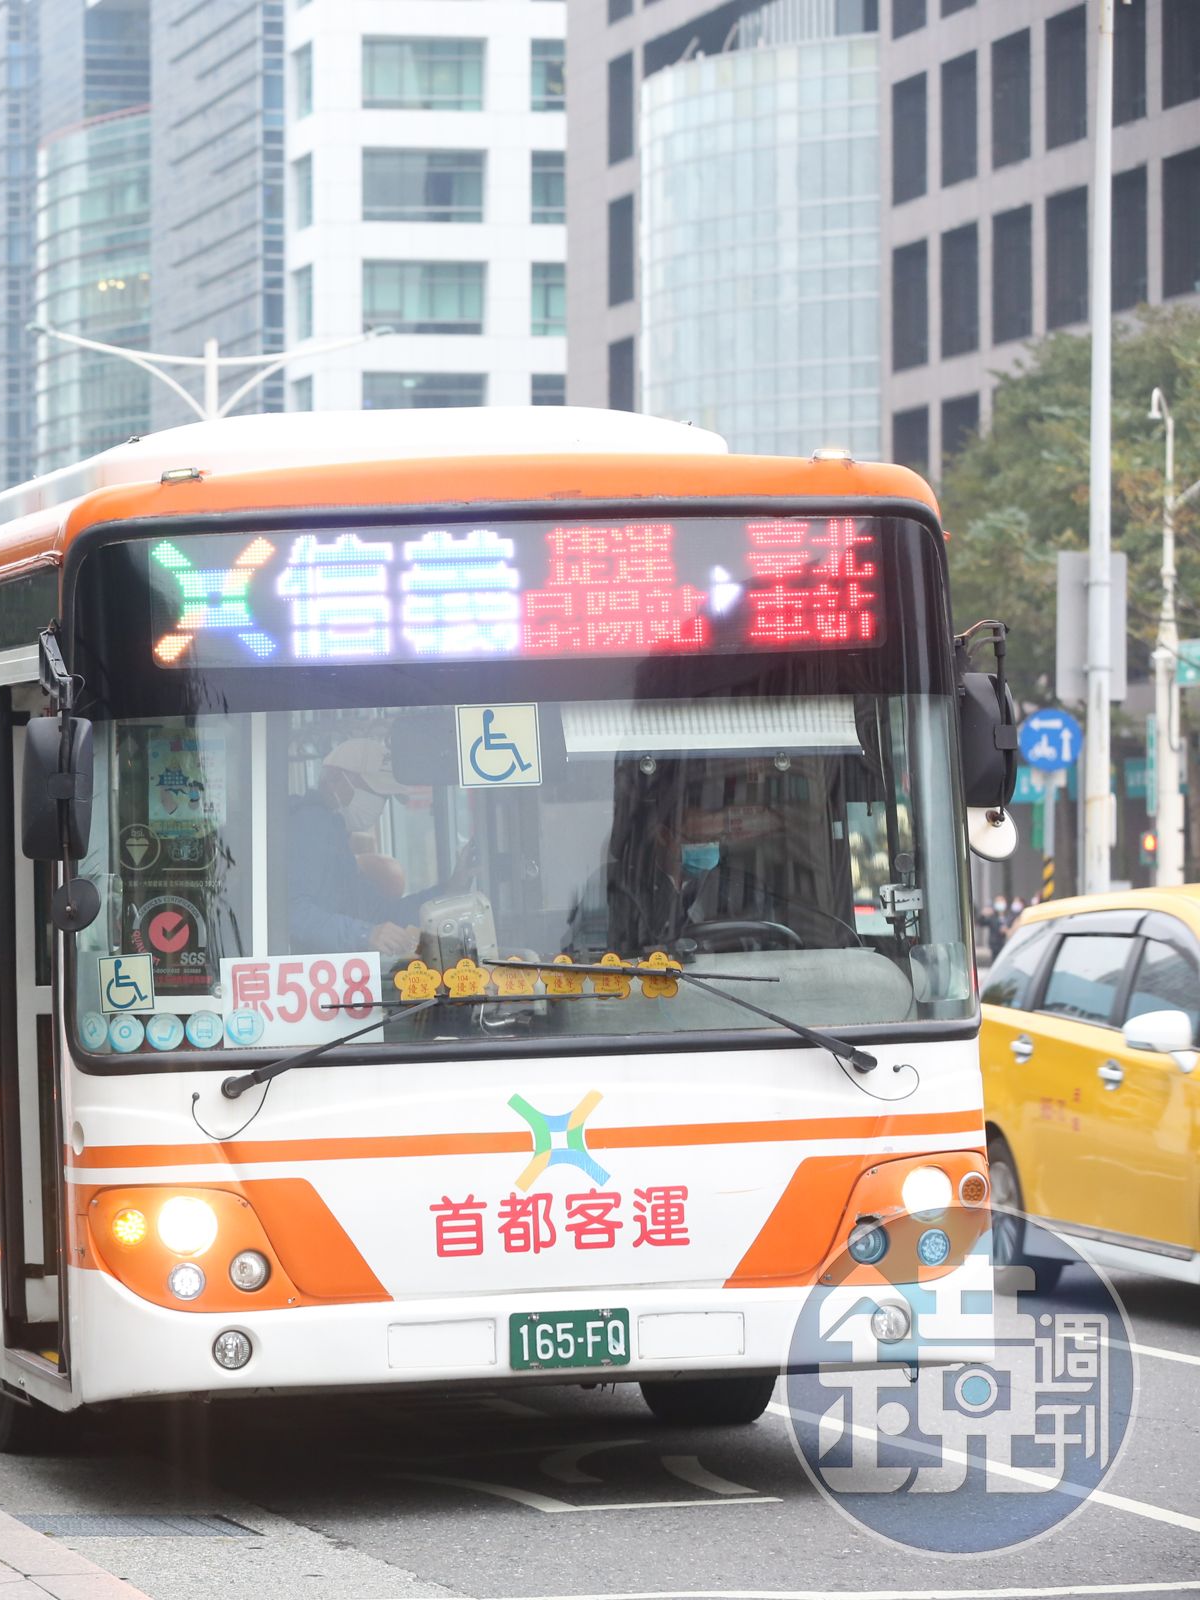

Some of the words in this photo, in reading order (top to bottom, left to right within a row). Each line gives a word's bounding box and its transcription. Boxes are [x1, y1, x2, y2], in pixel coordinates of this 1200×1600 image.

[547, 523, 673, 587] 捷運
[275, 529, 520, 659] 信義
[180, 952, 206, 965] SGS
[231, 957, 374, 1024] 原588
[429, 1185, 690, 1257] 首都客運
[519, 1319, 626, 1361] 165-FQ
